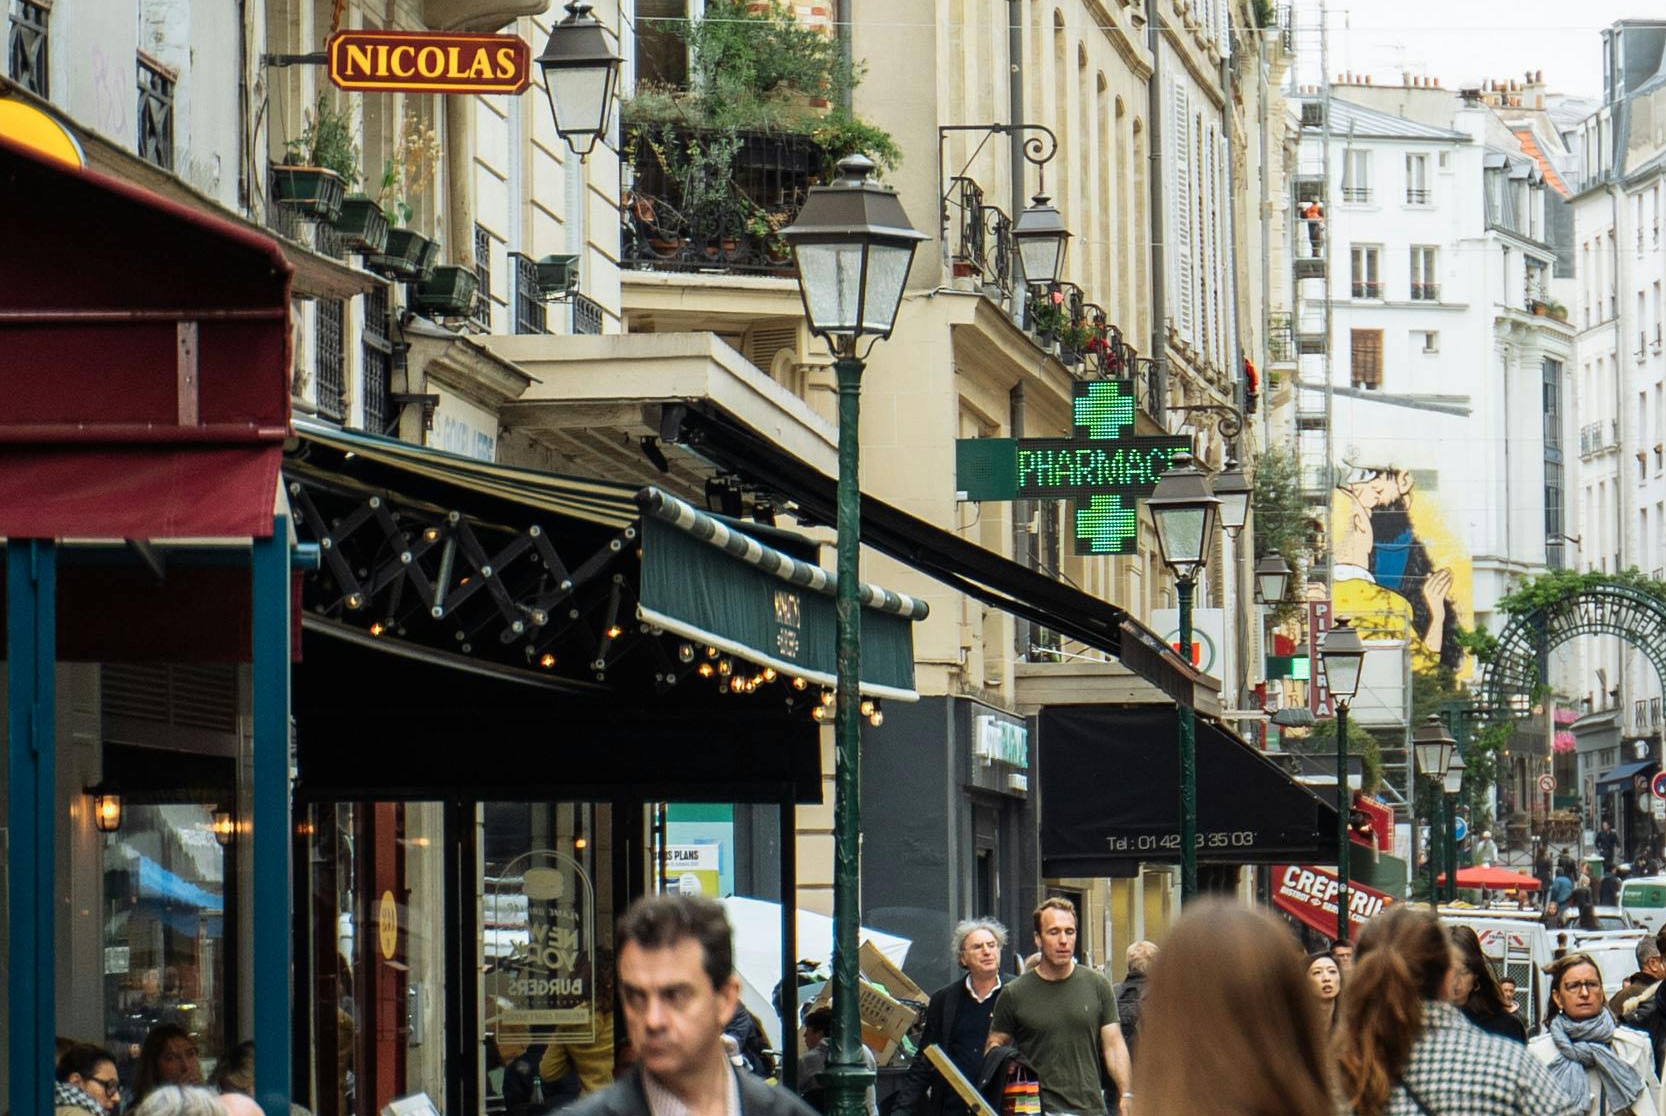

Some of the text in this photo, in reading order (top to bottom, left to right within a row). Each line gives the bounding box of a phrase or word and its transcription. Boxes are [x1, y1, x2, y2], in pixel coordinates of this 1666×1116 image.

[345, 44, 516, 80] NICOLAS
[1138, 835, 1156, 850] 01
[1159, 834, 1181, 849] 42
[1194, 833, 1205, 849] 3
[1208, 833, 1229, 847] 35
[1232, 832, 1254, 846] 03
[674, 850, 699, 860] PLANS
